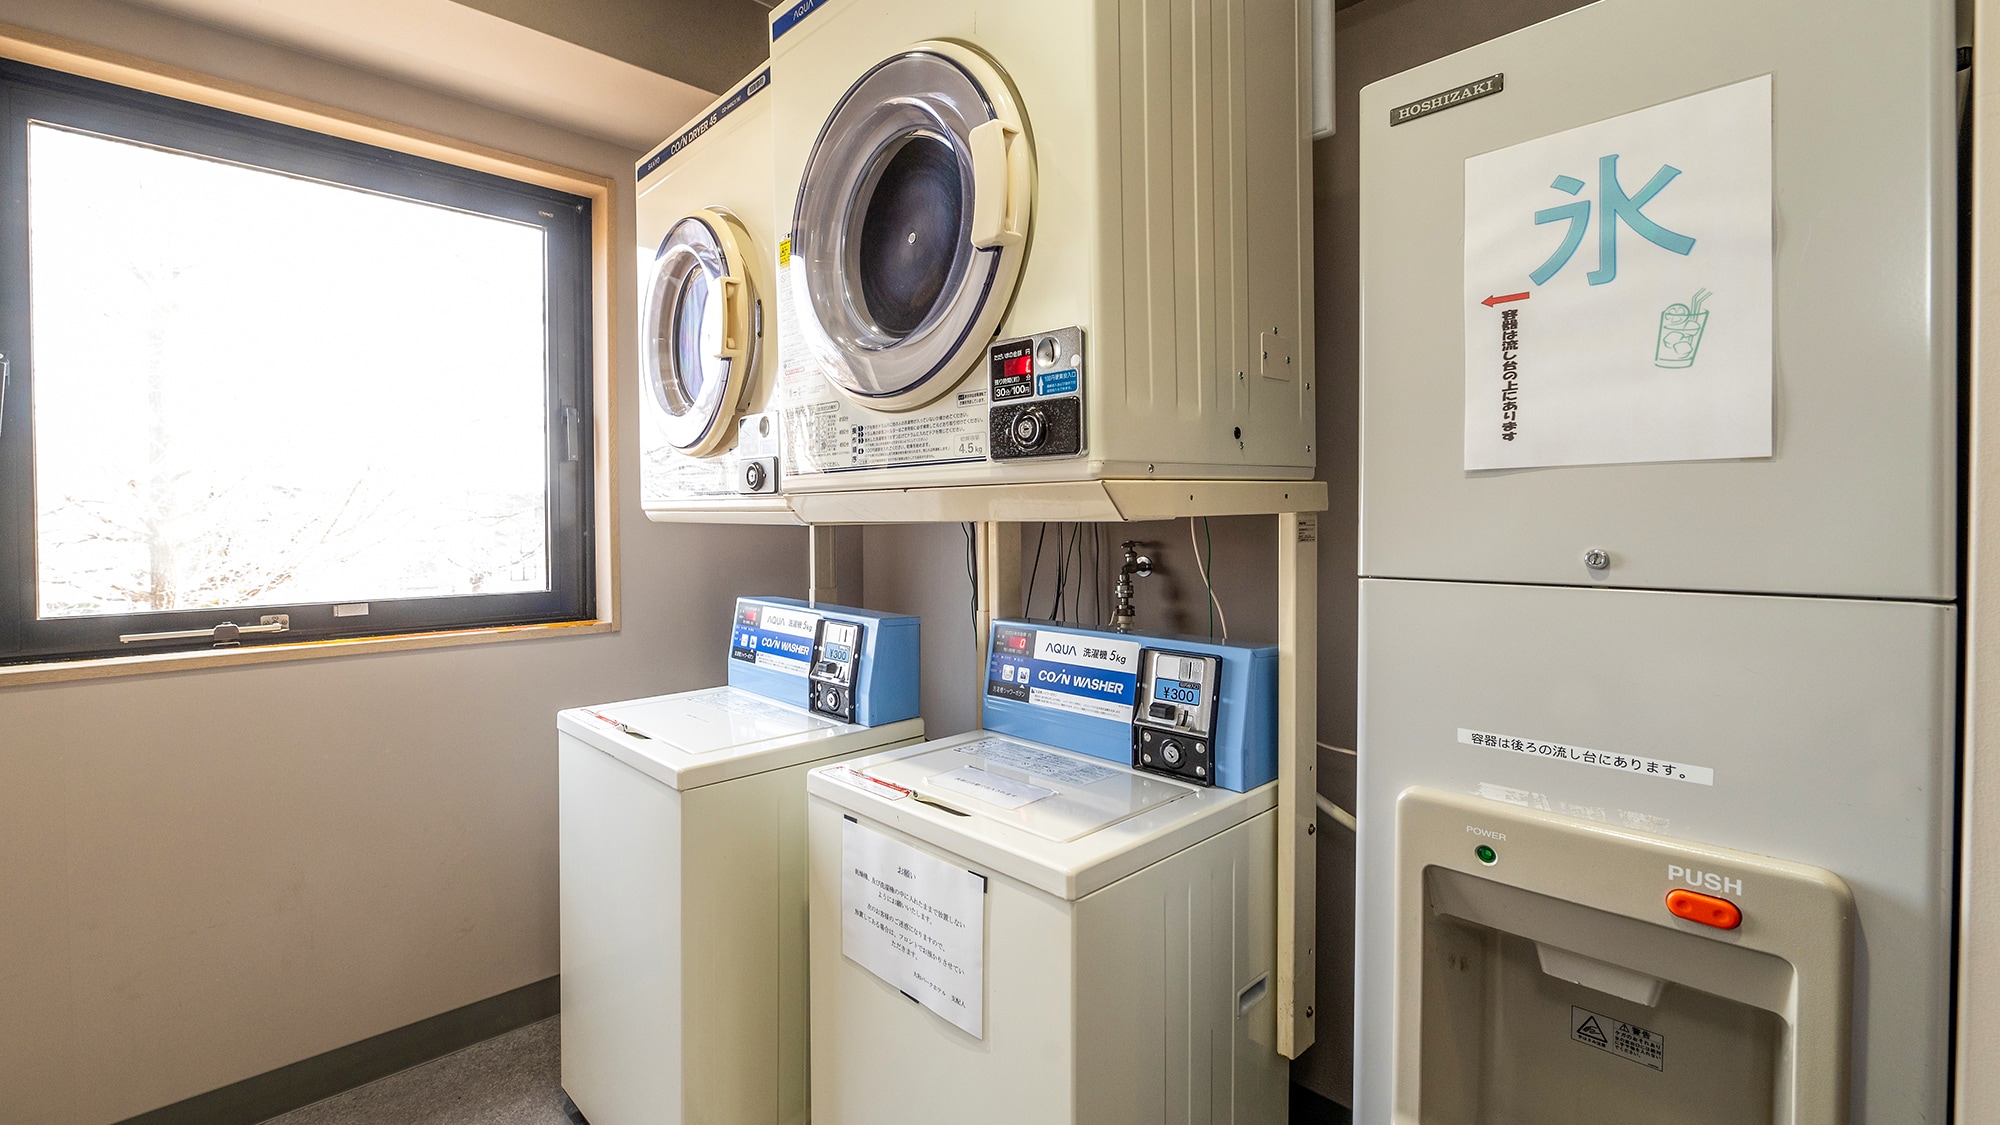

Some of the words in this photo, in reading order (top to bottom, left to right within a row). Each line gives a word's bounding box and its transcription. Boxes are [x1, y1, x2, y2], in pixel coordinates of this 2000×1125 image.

[1398, 79, 1494, 120] HOSHIZAKI
[688, 120, 709, 143] DRYER
[1529, 154, 1696, 286] 氷
[1501, 309, 1518, 442] 容器は流し台の上にあります
[780, 641, 810, 655] WASHER
[1020, 638, 1026, 649] 0
[1045, 642, 1077, 657] AQUA
[1083, 647, 1108, 661] 洗濯機
[1109, 649, 1127, 666] 5kg
[1038, 668, 1073, 691] COIN
[1073, 676, 1124, 696] WASHER
[1163, 686, 1195, 702] ¥300
[1471, 733, 1687, 780] 容器は後ろの流し台にあります。
[1466, 825, 1507, 841] POWER
[896, 866, 917, 880] お願い
[1668, 864, 1743, 897] PUSH
[878, 891, 933, 925] ようにお願いいたします。
[891, 940, 919, 960] ただきます。
